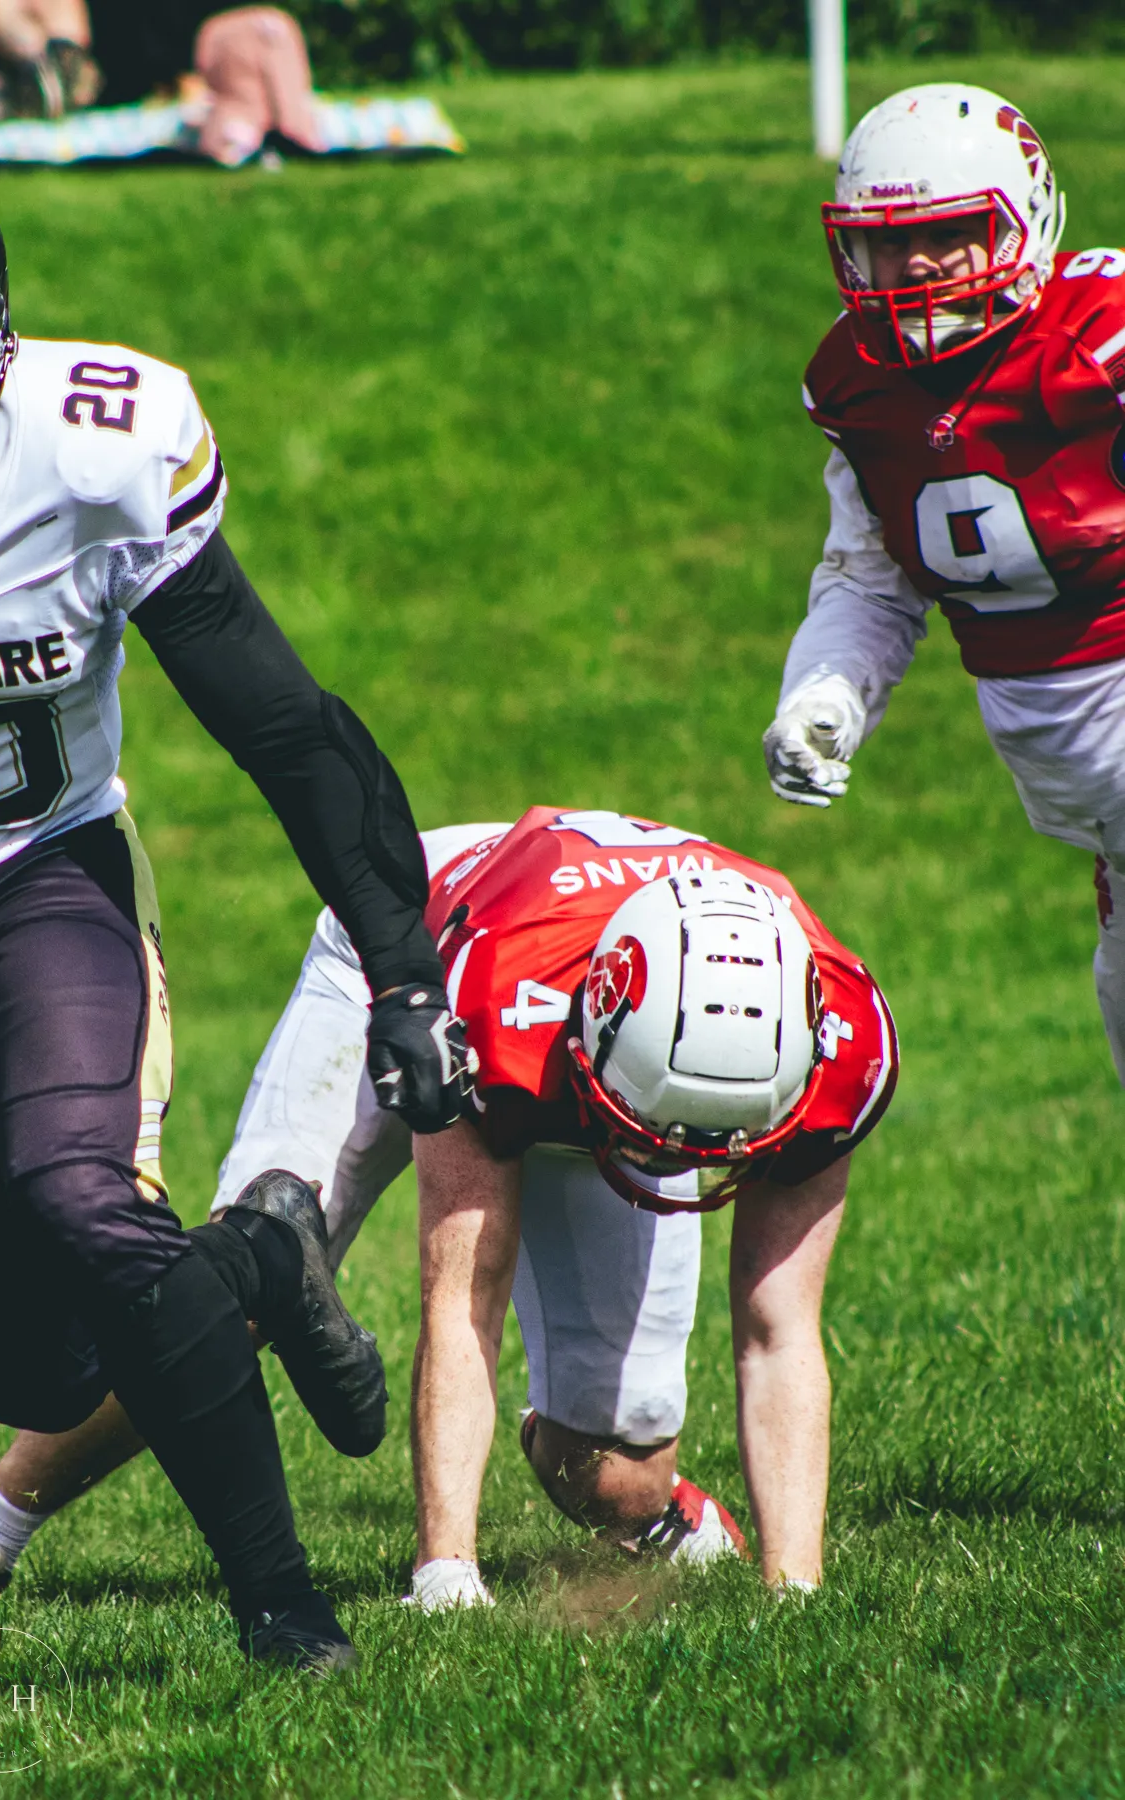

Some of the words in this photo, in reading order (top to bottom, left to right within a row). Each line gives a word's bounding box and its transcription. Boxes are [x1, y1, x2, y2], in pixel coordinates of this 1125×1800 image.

[60, 361, 142, 437] 20
[916, 472, 1060, 613] 9
[500, 979, 572, 1031] 4
